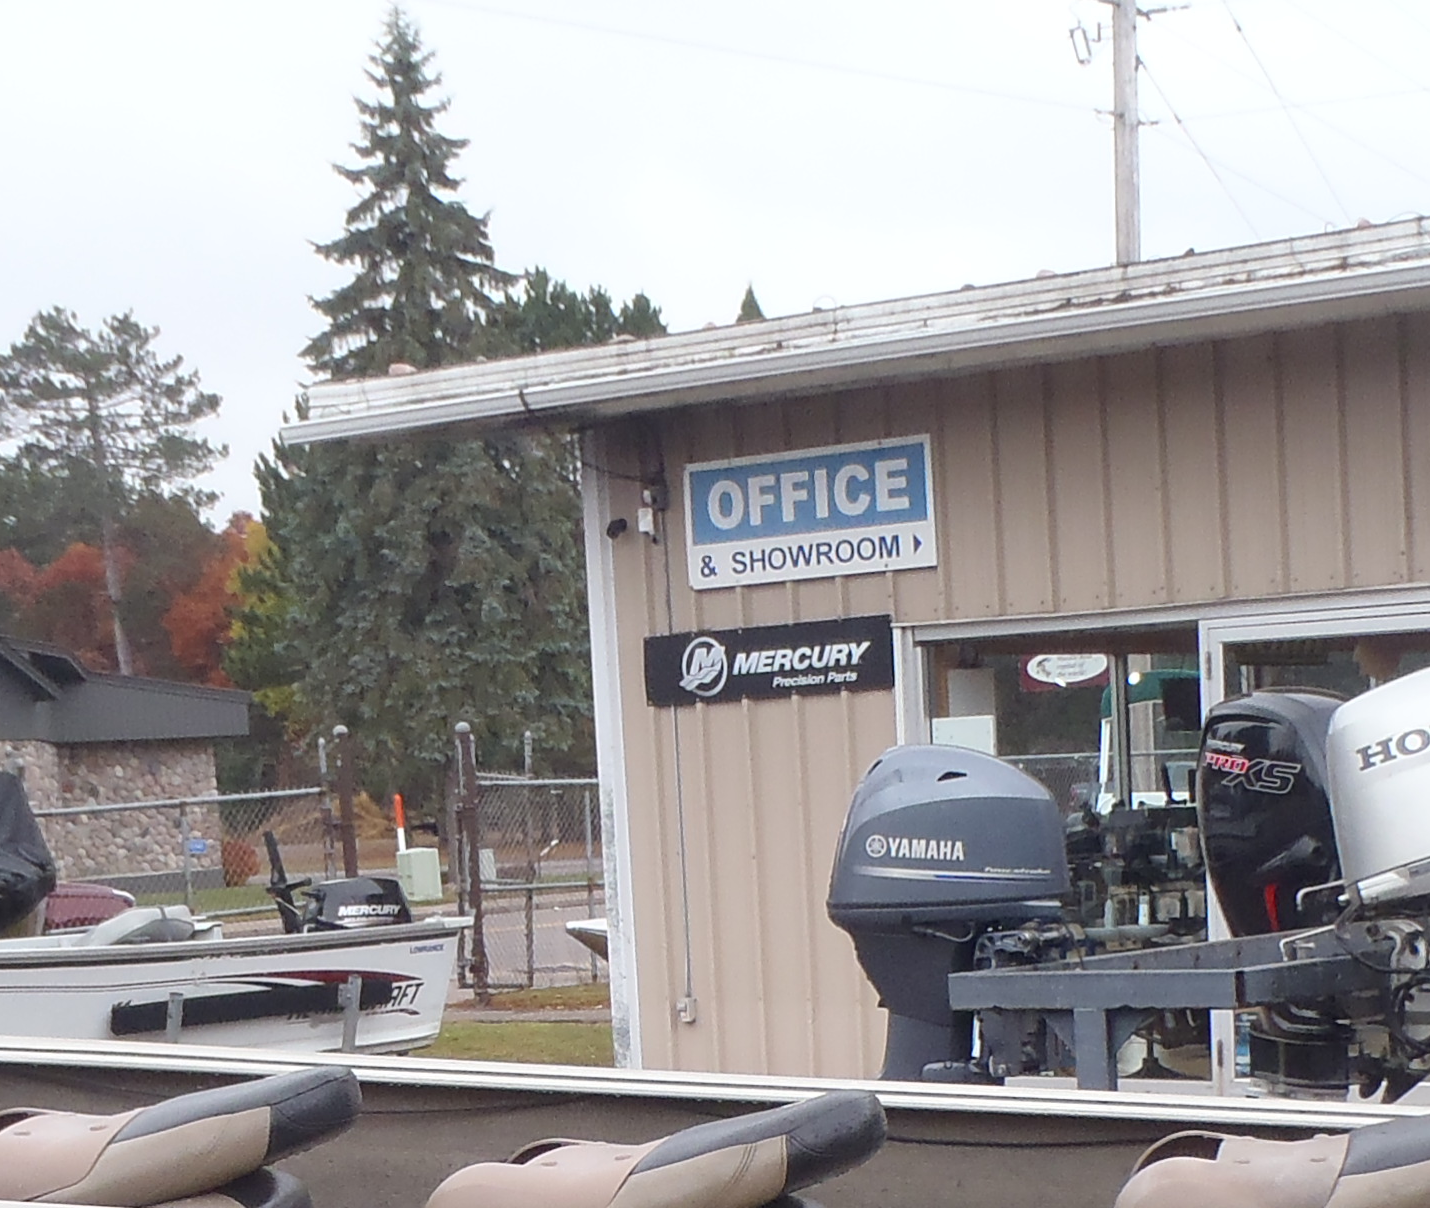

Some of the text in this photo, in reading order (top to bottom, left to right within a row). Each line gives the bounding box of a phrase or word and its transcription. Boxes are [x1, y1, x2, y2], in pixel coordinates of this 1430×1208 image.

[707, 458, 911, 531] OFFICE
[700, 534, 901, 578] & SHOWROOM
[732, 641, 871, 676] MERCURY
[772, 670, 858, 688] Precision Parts
[888, 837, 965, 861] YAMAHA
[338, 904, 401, 917] MERCURY
